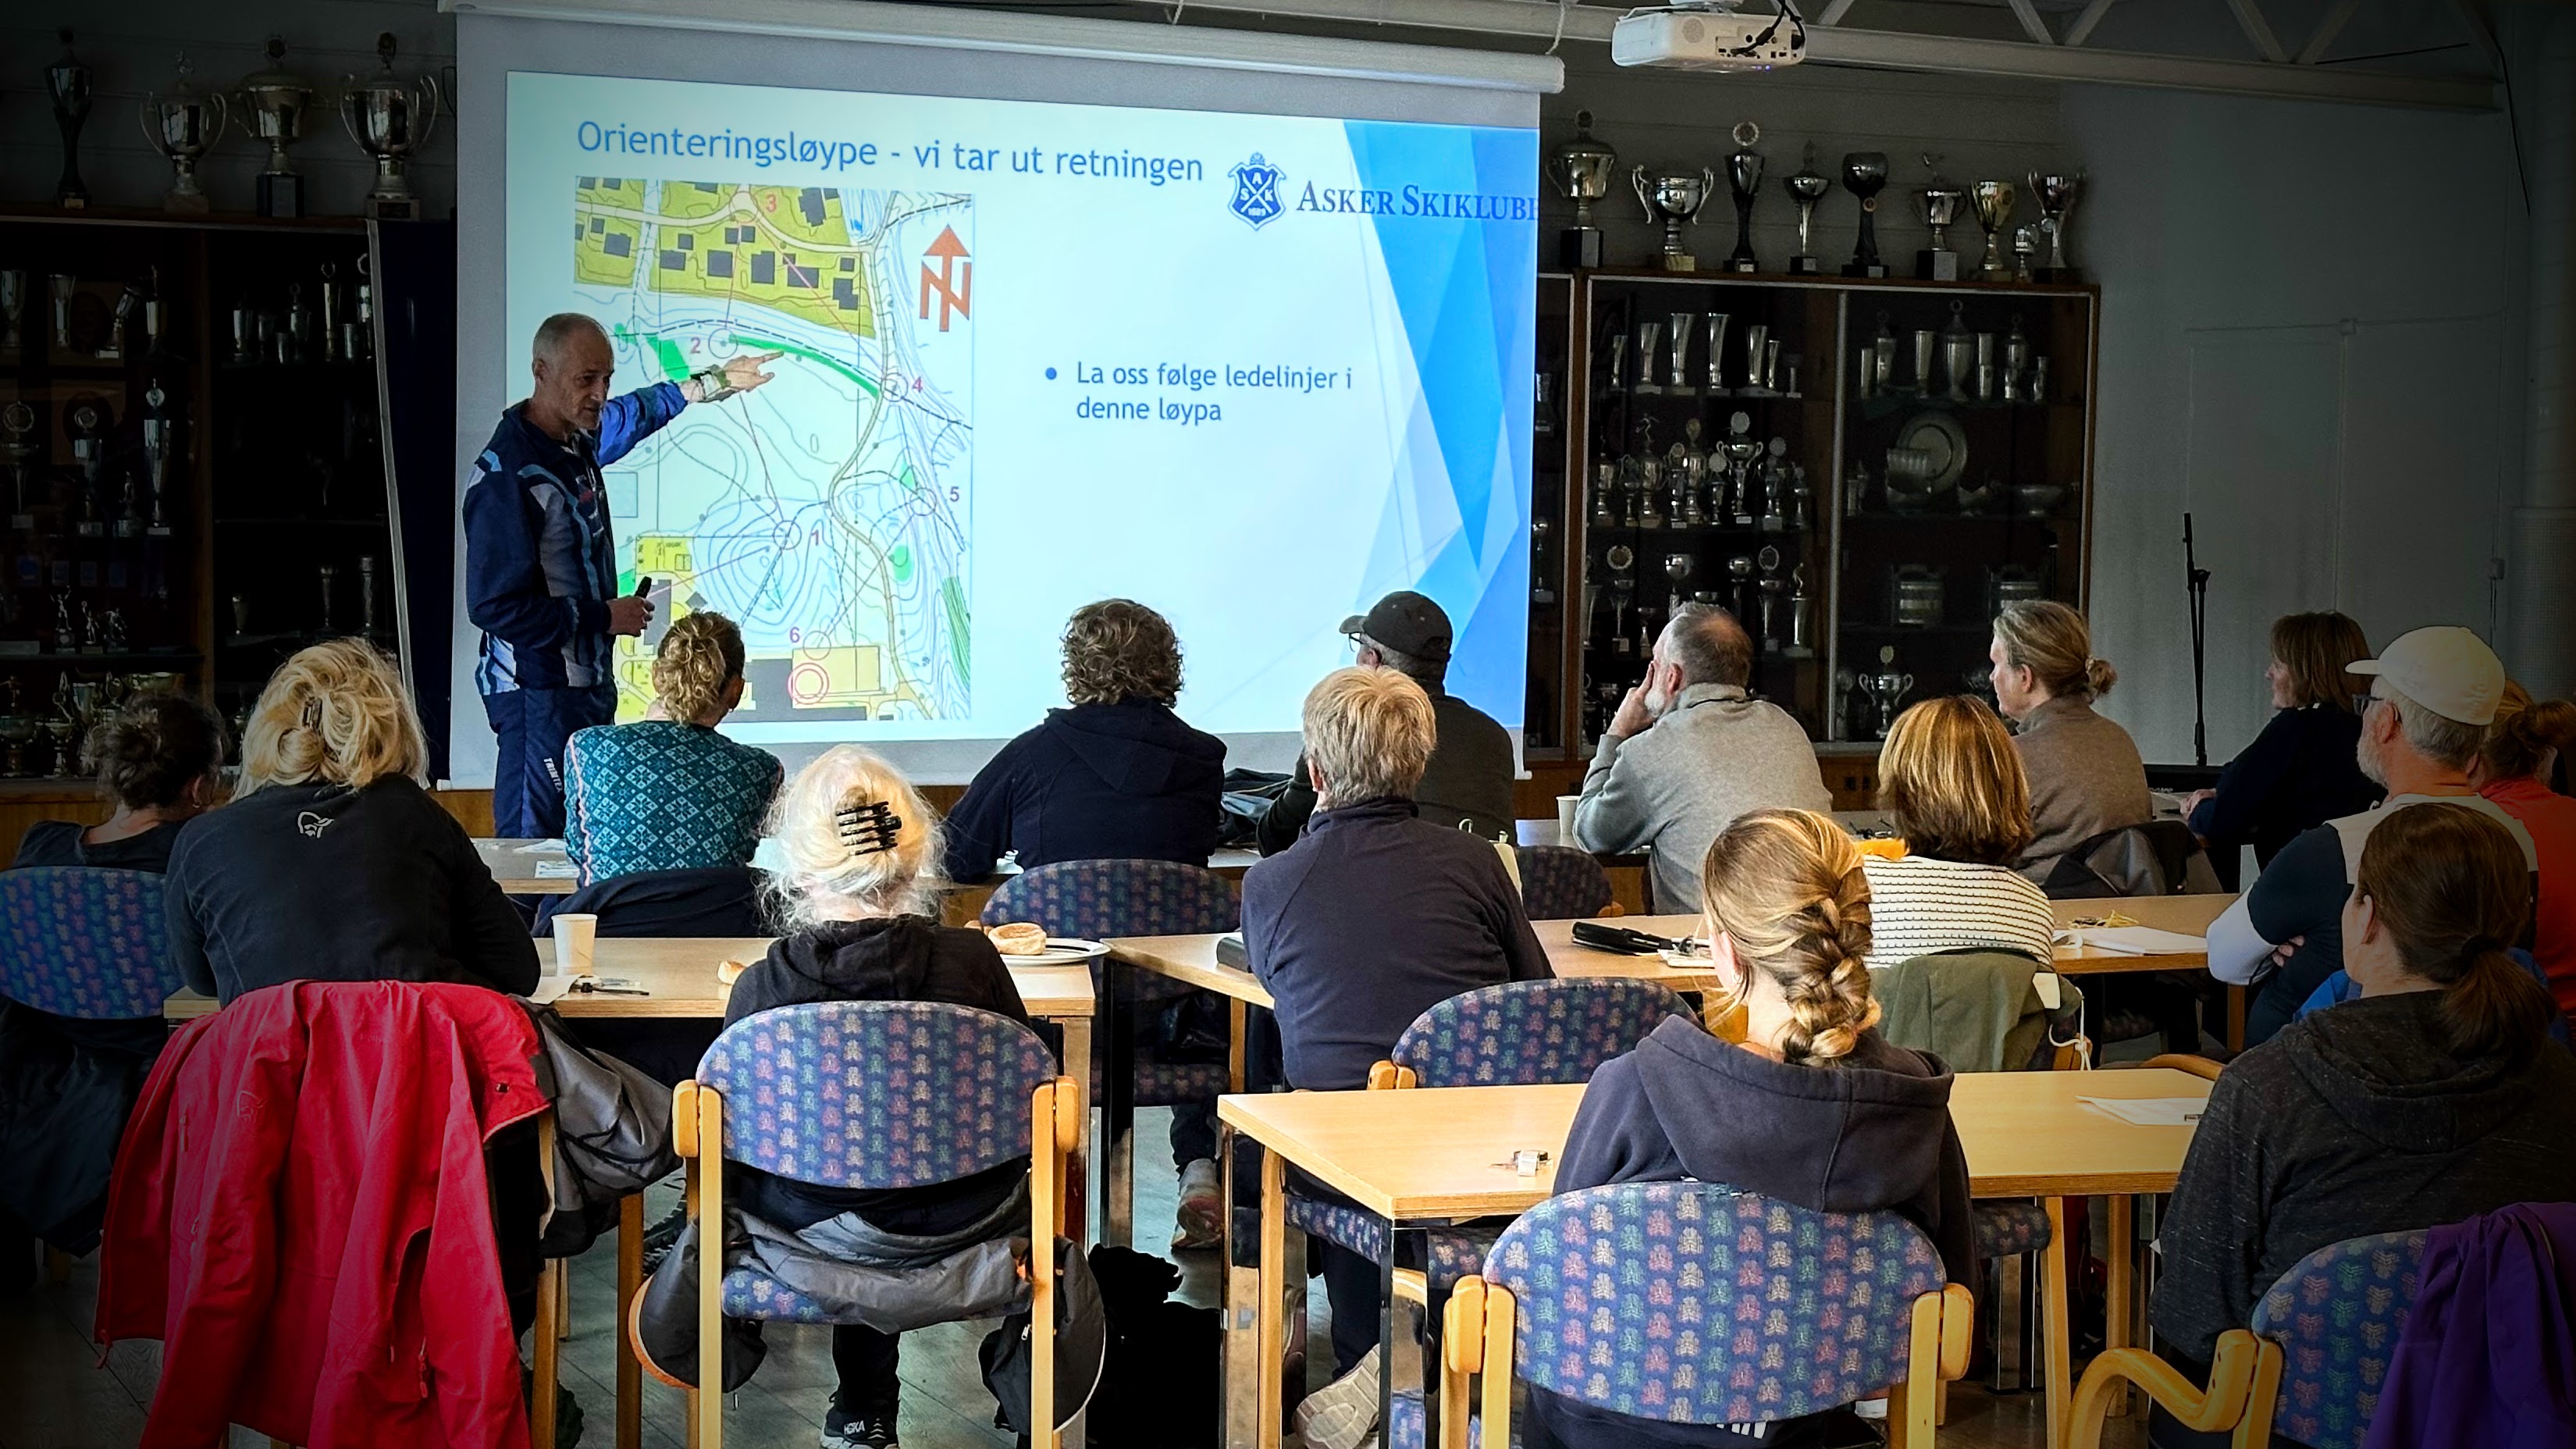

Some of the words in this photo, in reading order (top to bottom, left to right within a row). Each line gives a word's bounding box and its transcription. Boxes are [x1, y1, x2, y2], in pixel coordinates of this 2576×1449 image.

[577, 120, 878, 170] Orienteringsløype
[914, 140, 941, 169] vi
[954, 143, 1000, 171] tar
[1012, 148, 1044, 175] ut
[1057, 150, 1203, 187] retningen
[764, 194, 777, 212] 3
[1296, 180, 1396, 215] ASKER
[690, 336, 702, 355] 2
[912, 376, 924, 394] 4
[1077, 361, 1105, 385] La
[1113, 368, 1149, 386] oss
[1158, 363, 1218, 393] følge
[1226, 365, 1339, 394] ledelinjer
[1347, 368, 1353, 390] i
[1076, 397, 1151, 421] denne
[1160, 397, 1222, 428] løypa
[949, 486, 959, 504] 5
[811, 529, 820, 546] 1
[789, 626, 801, 644] 6
